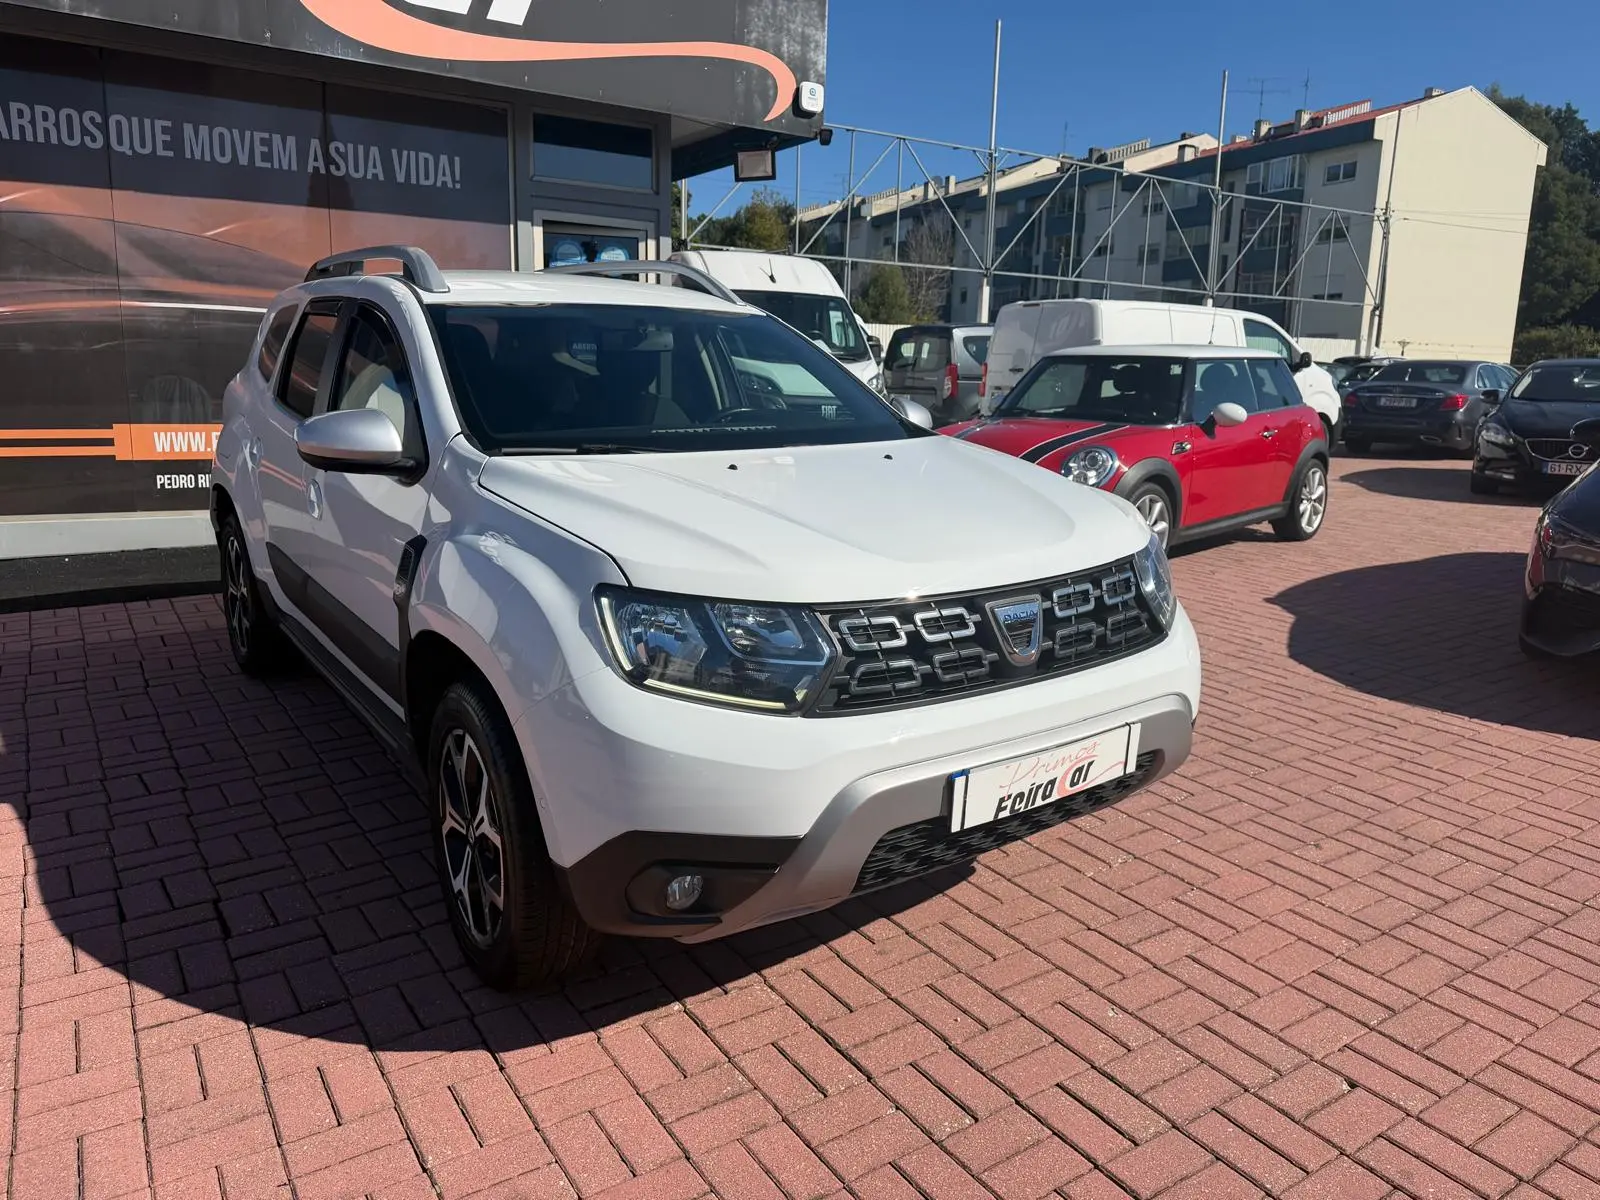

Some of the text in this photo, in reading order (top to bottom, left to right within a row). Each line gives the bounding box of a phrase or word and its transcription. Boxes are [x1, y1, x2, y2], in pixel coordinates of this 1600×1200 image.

[108, 114, 174, 156] QUE
[182, 122, 298, 172] MOVEM
[307, 138, 326, 174] A
[328, 140, 385, 181] SUA
[391, 148, 461, 189] VIDA!
[156, 473, 211, 489] PEDRO RI
